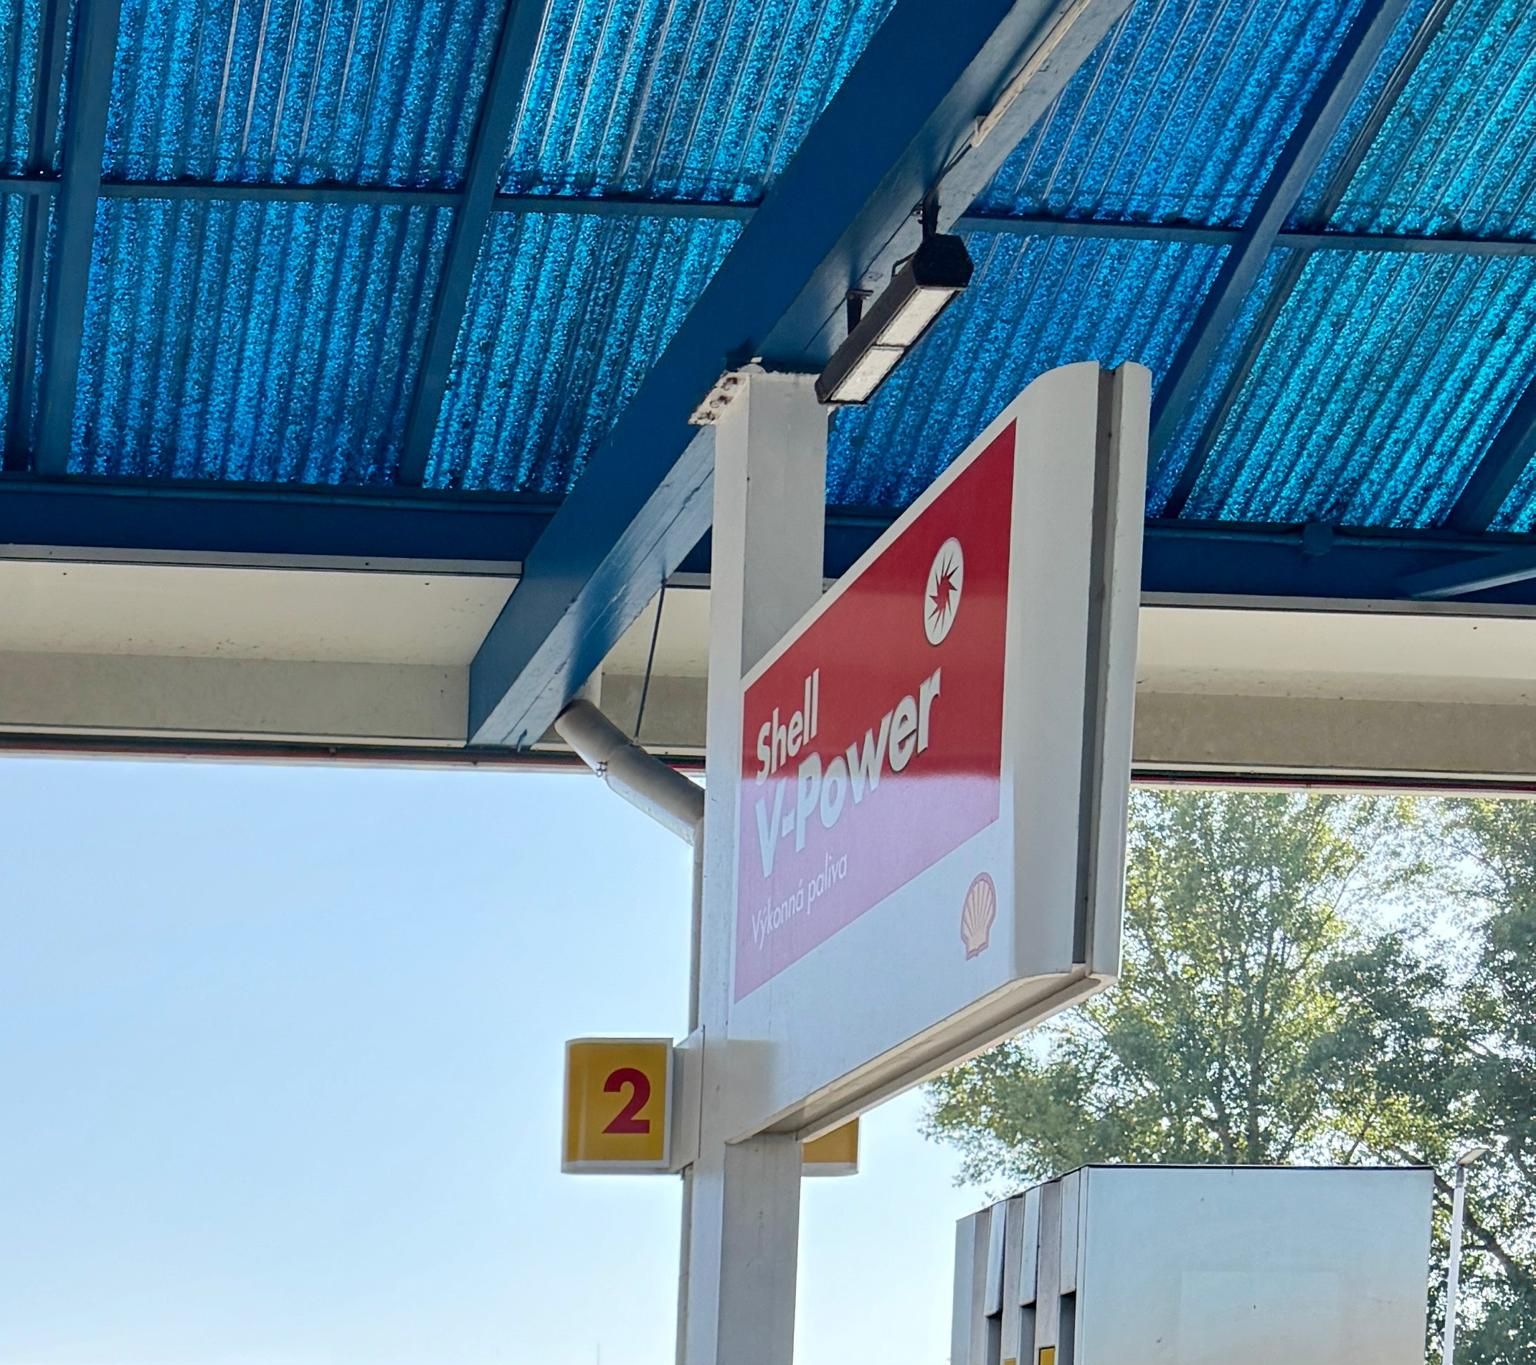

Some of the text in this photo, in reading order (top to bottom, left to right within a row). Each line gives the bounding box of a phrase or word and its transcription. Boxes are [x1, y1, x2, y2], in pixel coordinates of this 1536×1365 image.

[755, 668, 942, 880] V-Power
[756, 668, 820, 786] Shell
[751, 852, 849, 951] Výkonná paliva
[602, 1067, 652, 1134] 2
